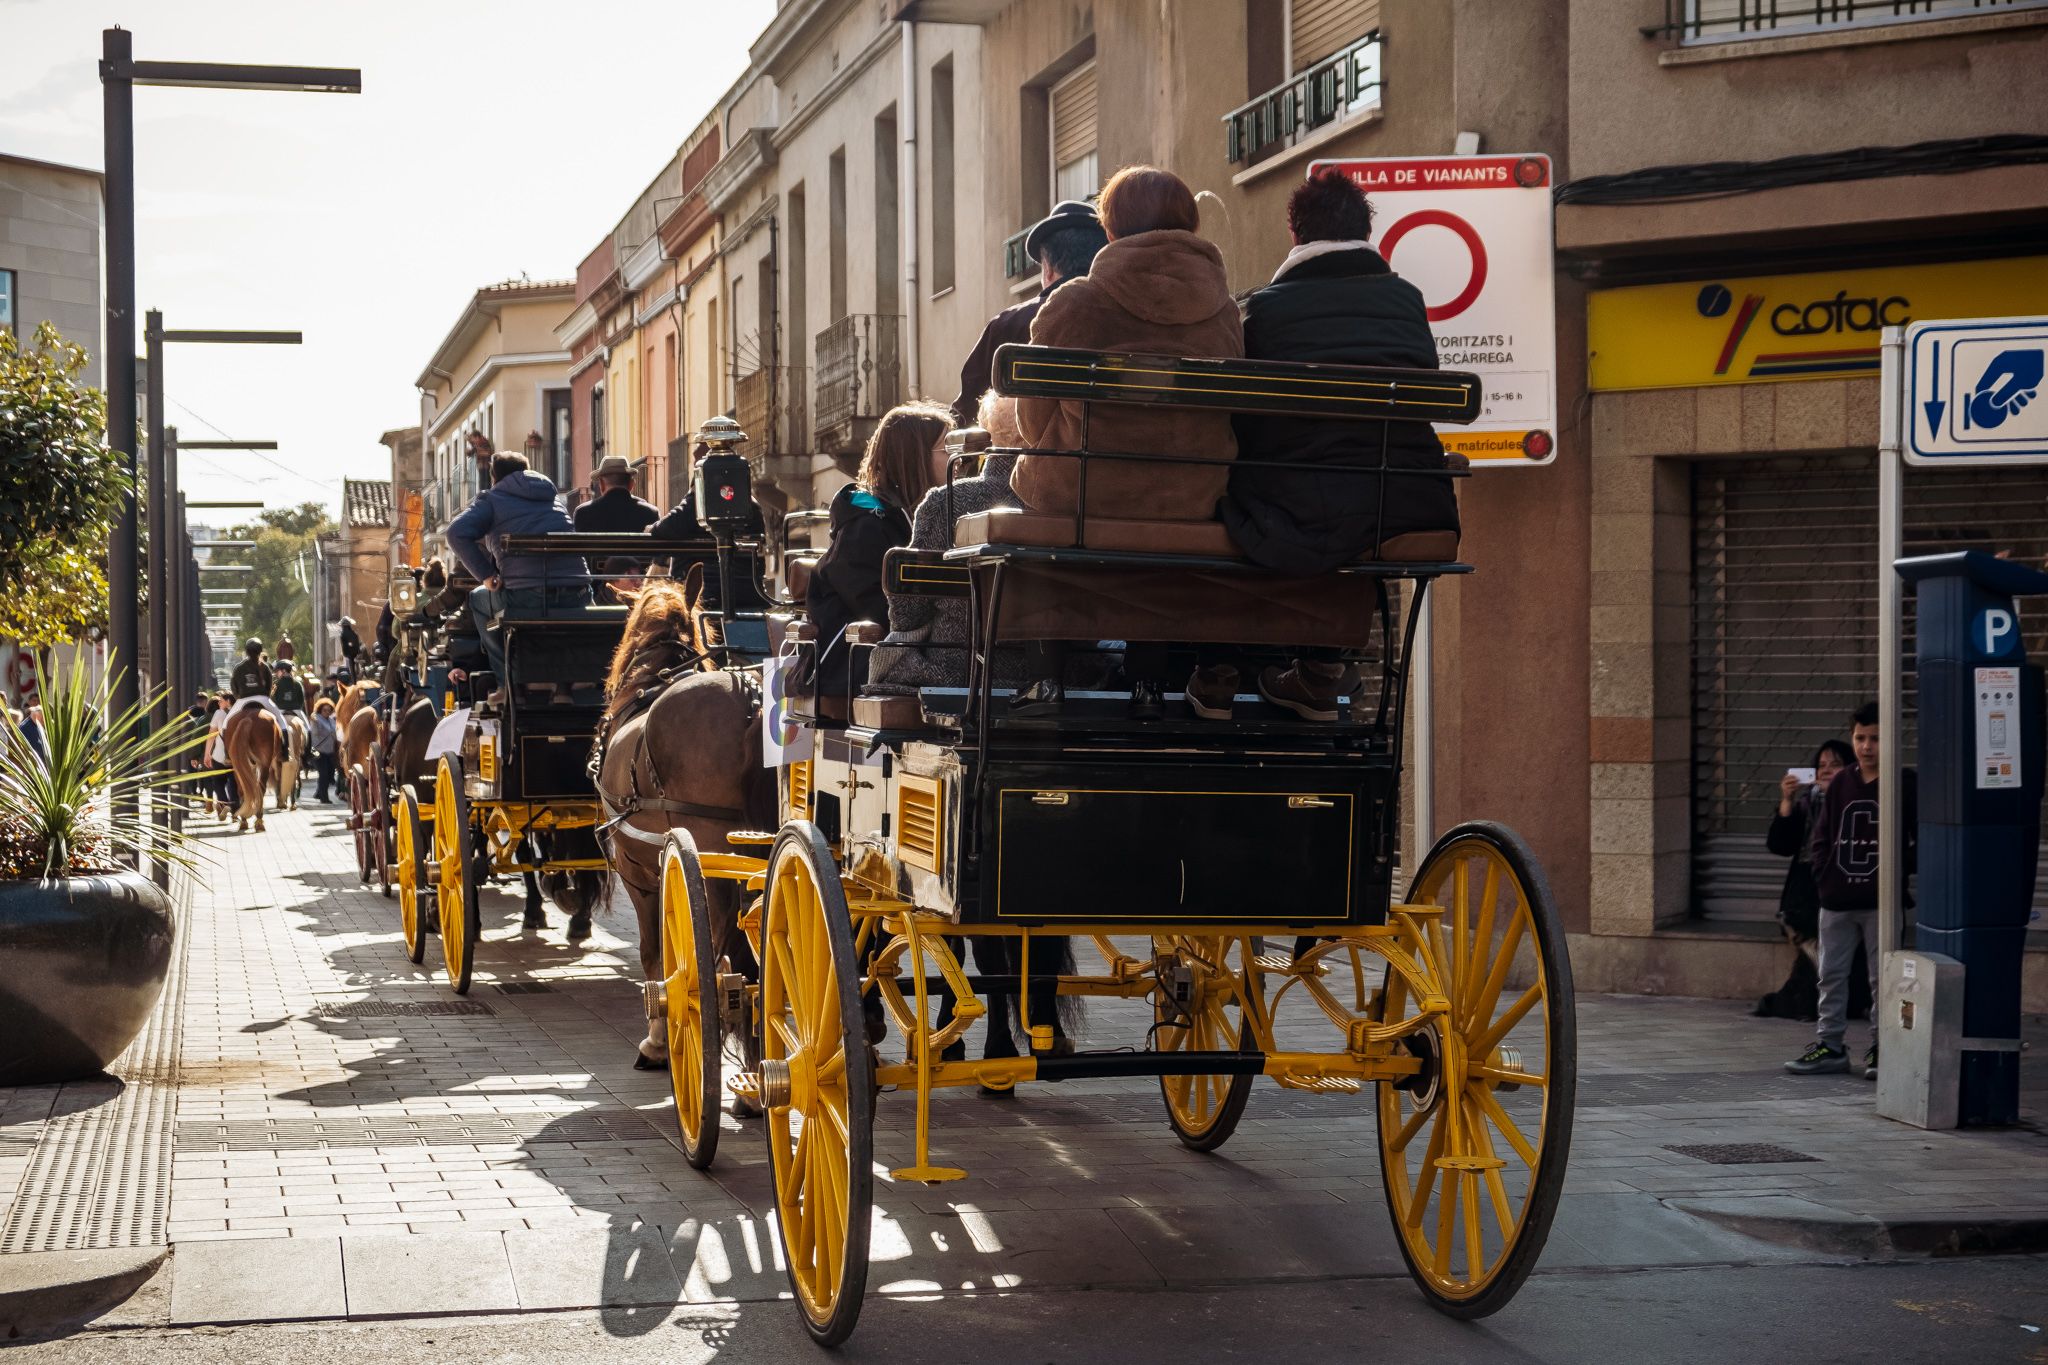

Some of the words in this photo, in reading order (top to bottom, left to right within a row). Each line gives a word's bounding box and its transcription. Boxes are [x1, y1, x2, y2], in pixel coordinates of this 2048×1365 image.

[1395, 169, 1416, 183] DE
[1424, 166, 1508, 182] VIANANTS
[1771, 290, 1911, 336] cofac
[1509, 335, 1513, 346] I
[1491, 392, 1514, 400] 15-16
[1517, 392, 1523, 400] h
[1457, 438, 1523, 451] matrícules
[1986, 609, 2012, 654] P
